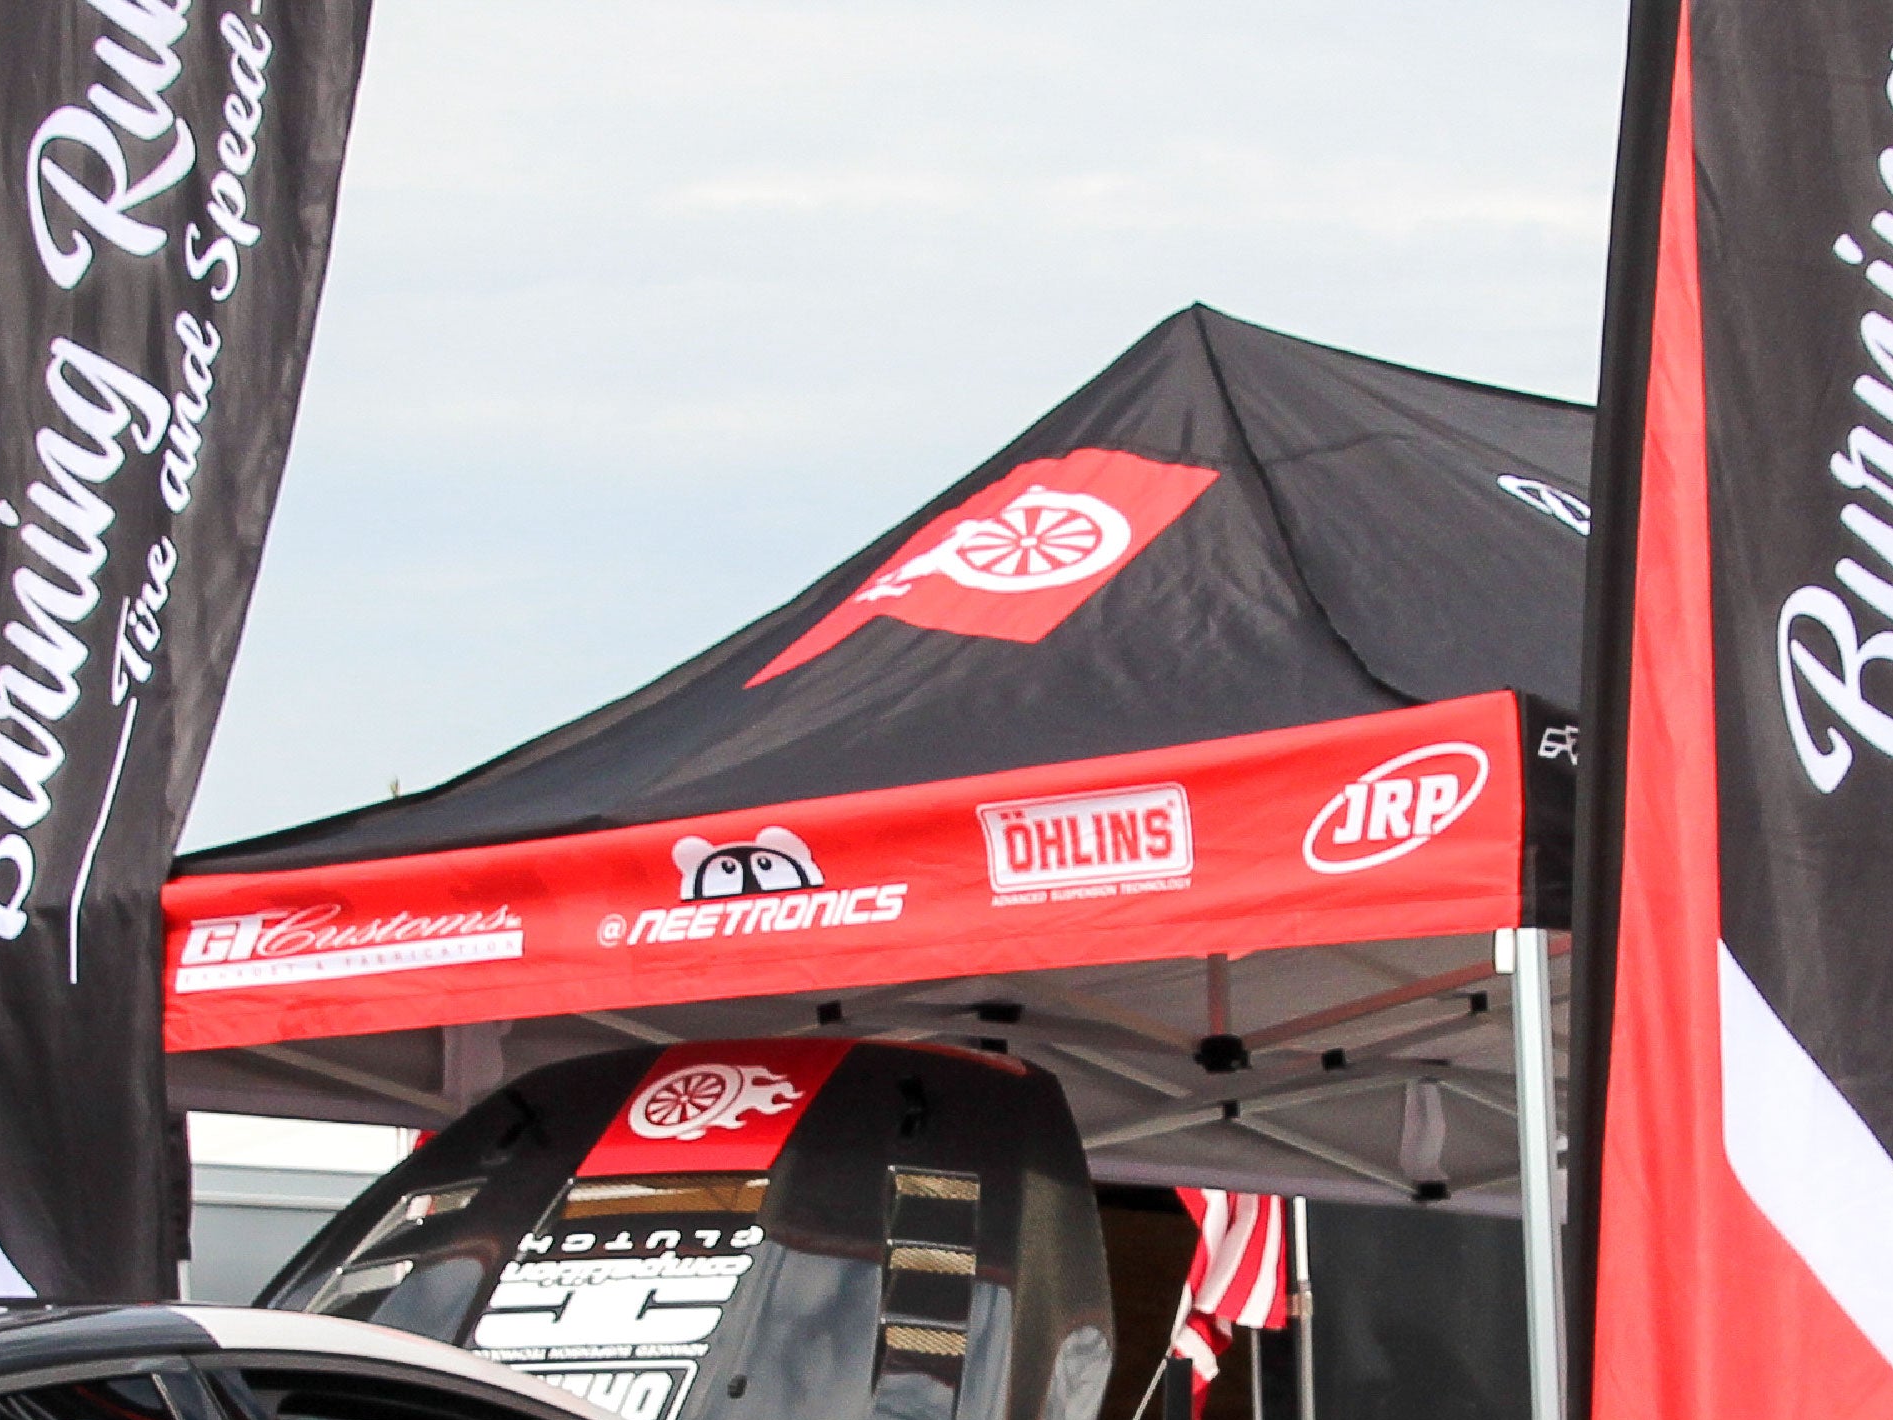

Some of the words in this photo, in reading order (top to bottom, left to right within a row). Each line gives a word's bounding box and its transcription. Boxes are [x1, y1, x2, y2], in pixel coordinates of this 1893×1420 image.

[186, 11, 273, 301] Speed
[160, 312, 222, 512] and
[111, 536, 180, 707] Tire
[1333, 773, 1461, 842] JRP
